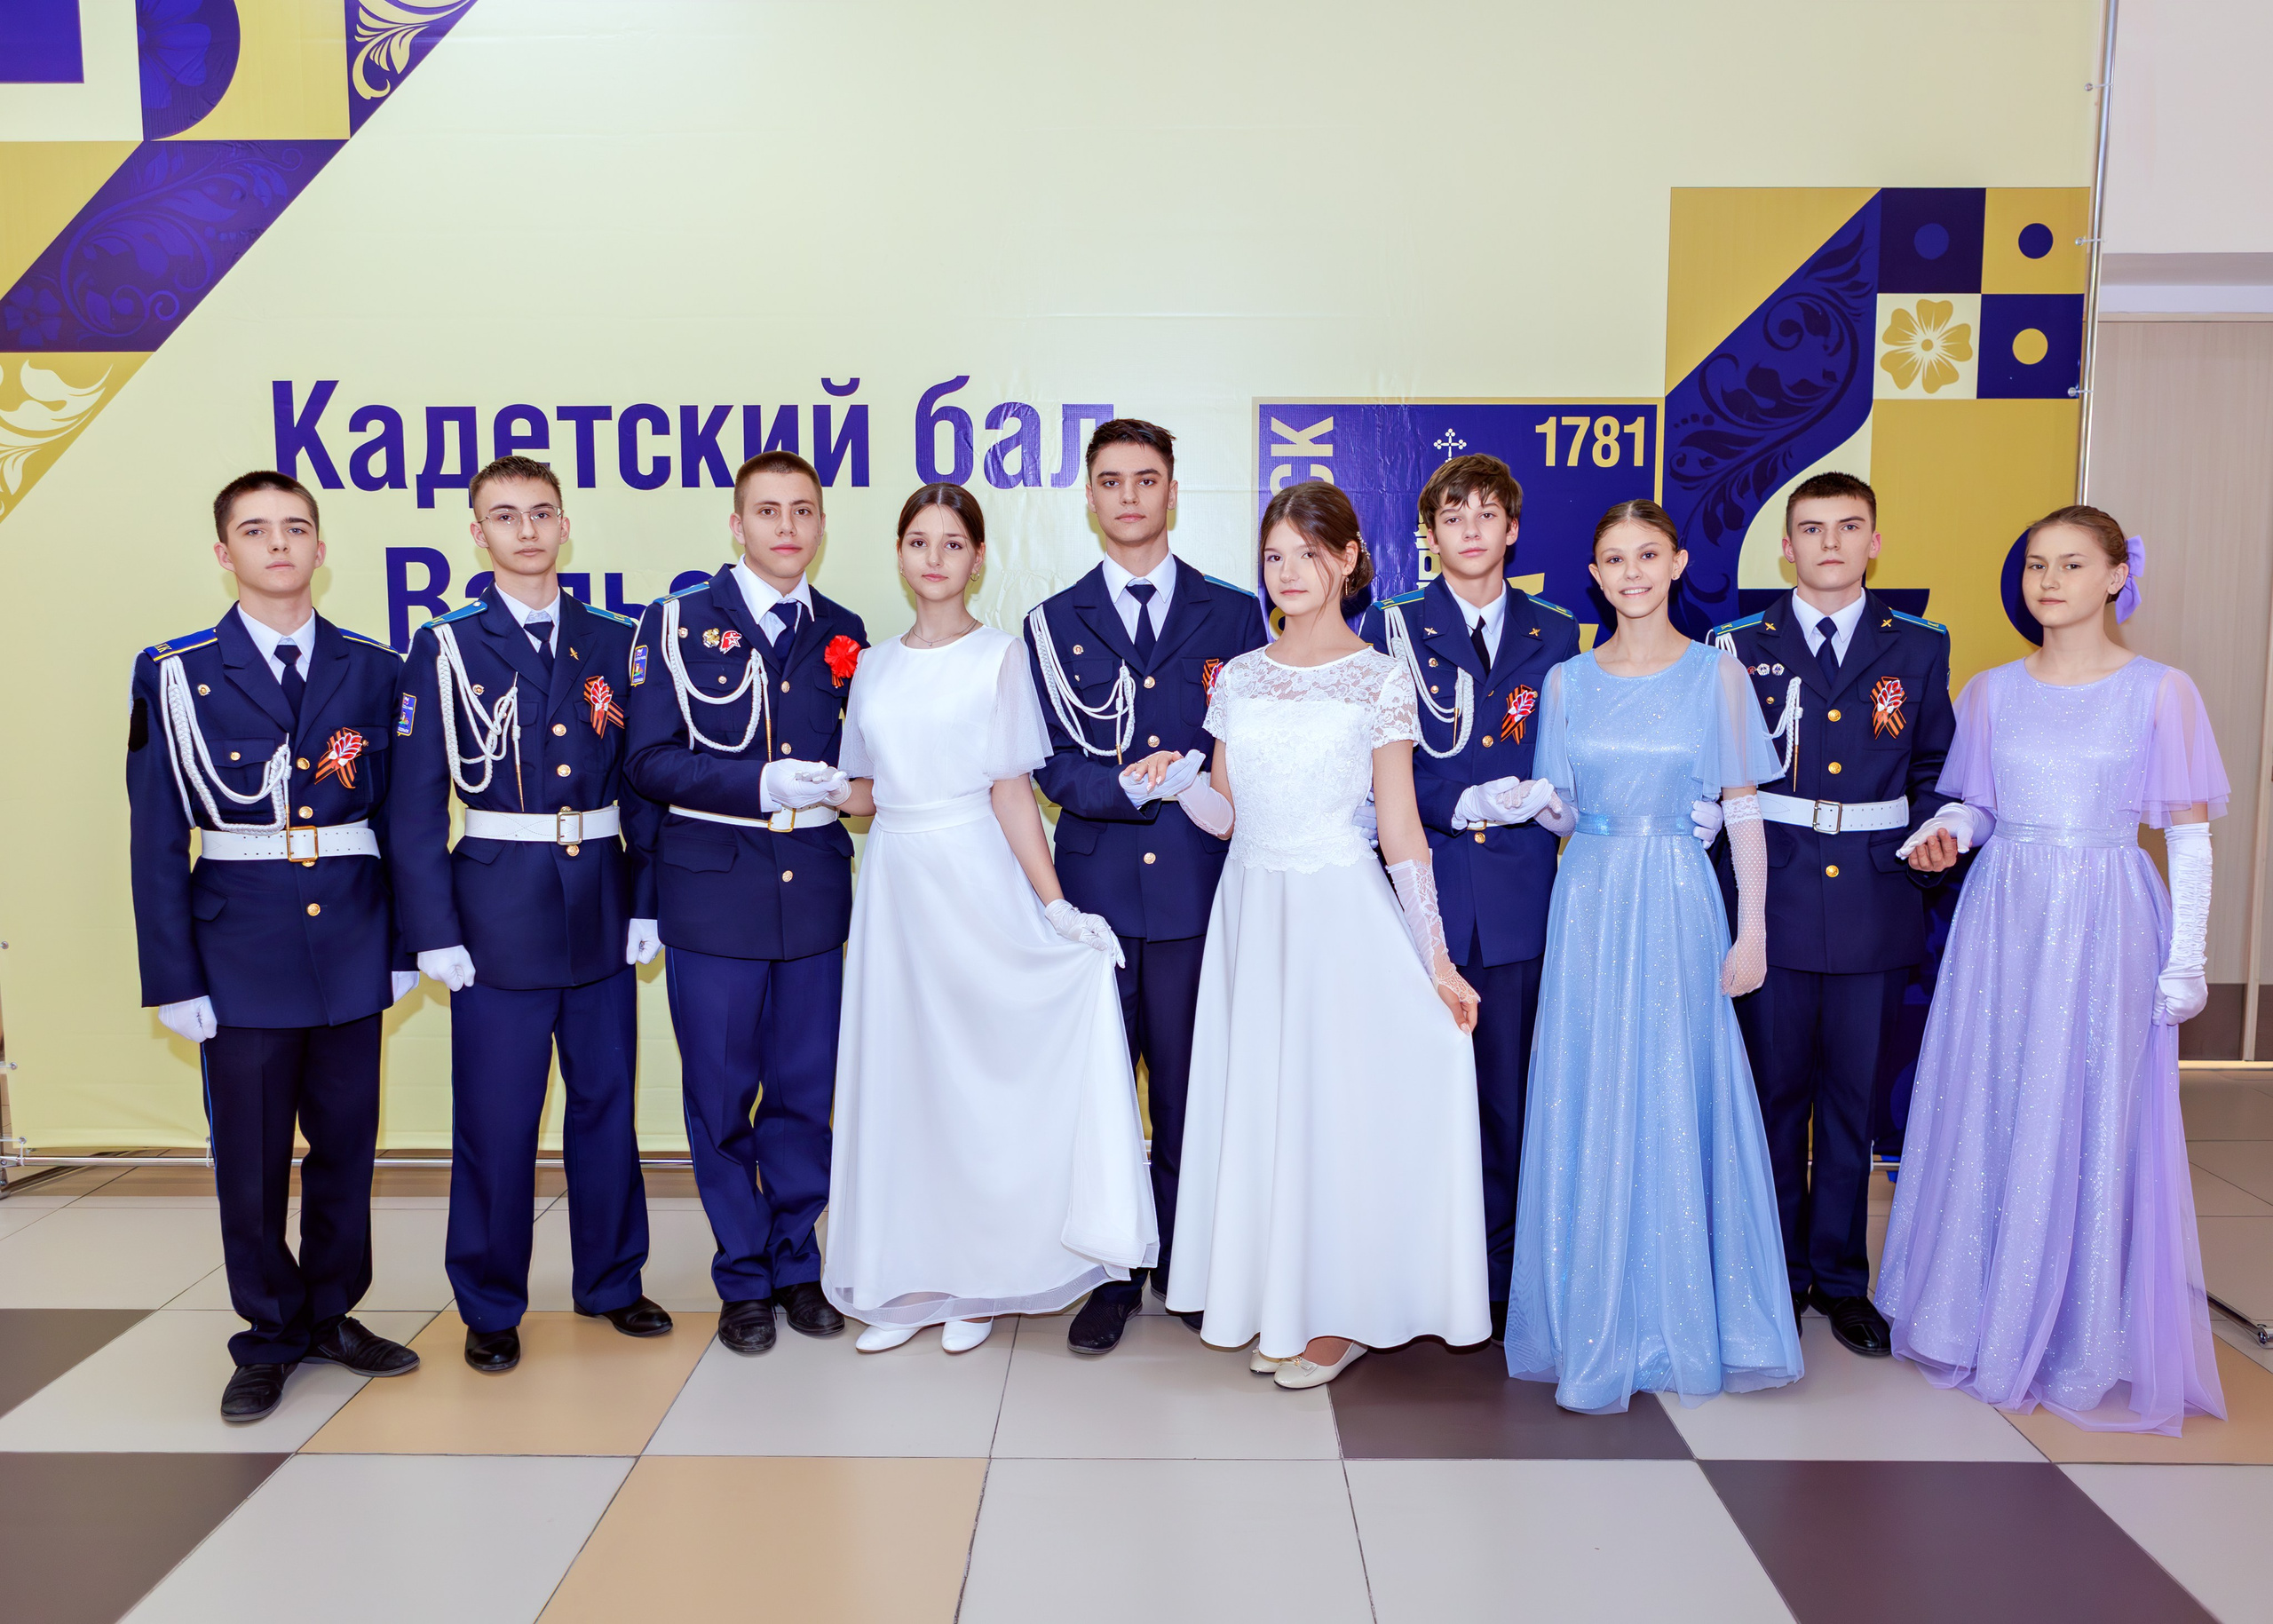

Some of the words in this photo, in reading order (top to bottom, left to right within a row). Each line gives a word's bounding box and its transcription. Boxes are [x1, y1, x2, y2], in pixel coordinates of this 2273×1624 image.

[272, 376, 870, 509] Кадетский
[915, 375, 1114, 489] бал
[1534, 416, 1645, 468] 1781
